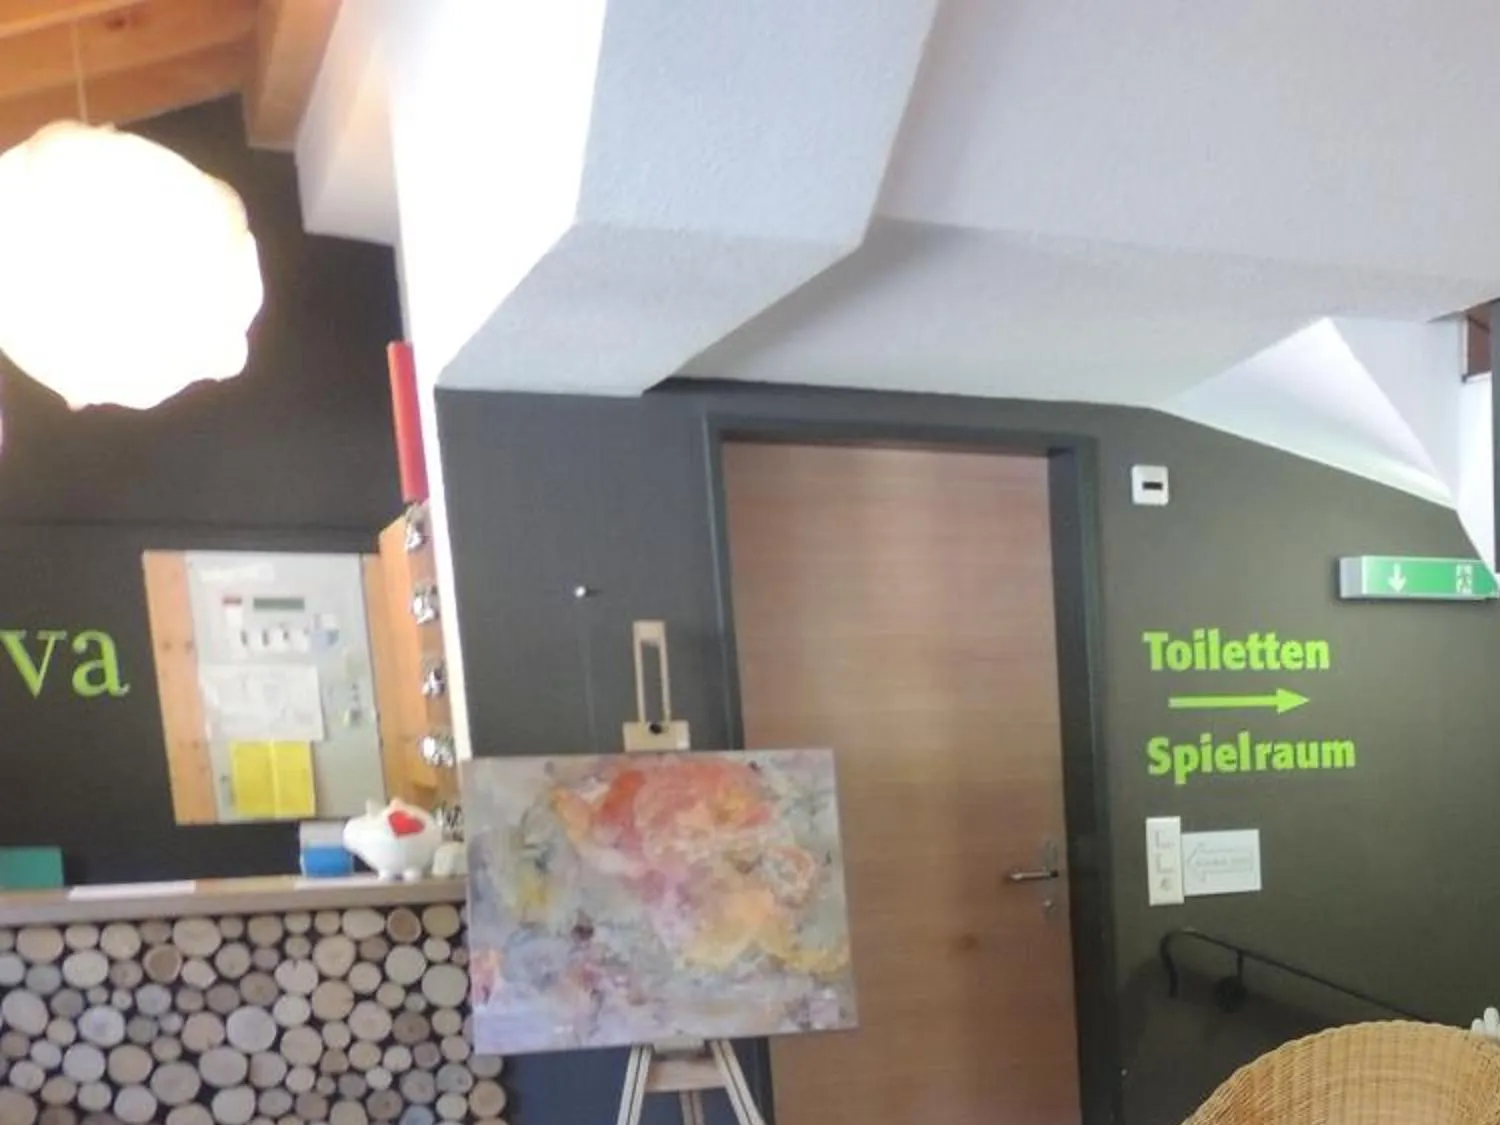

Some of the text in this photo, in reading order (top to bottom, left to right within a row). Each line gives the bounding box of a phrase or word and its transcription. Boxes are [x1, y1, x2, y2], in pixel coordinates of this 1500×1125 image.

[0, 629, 131, 699] va
[1142, 627, 1332, 672] Toiletten
[1146, 731, 1358, 786] Spielraum
